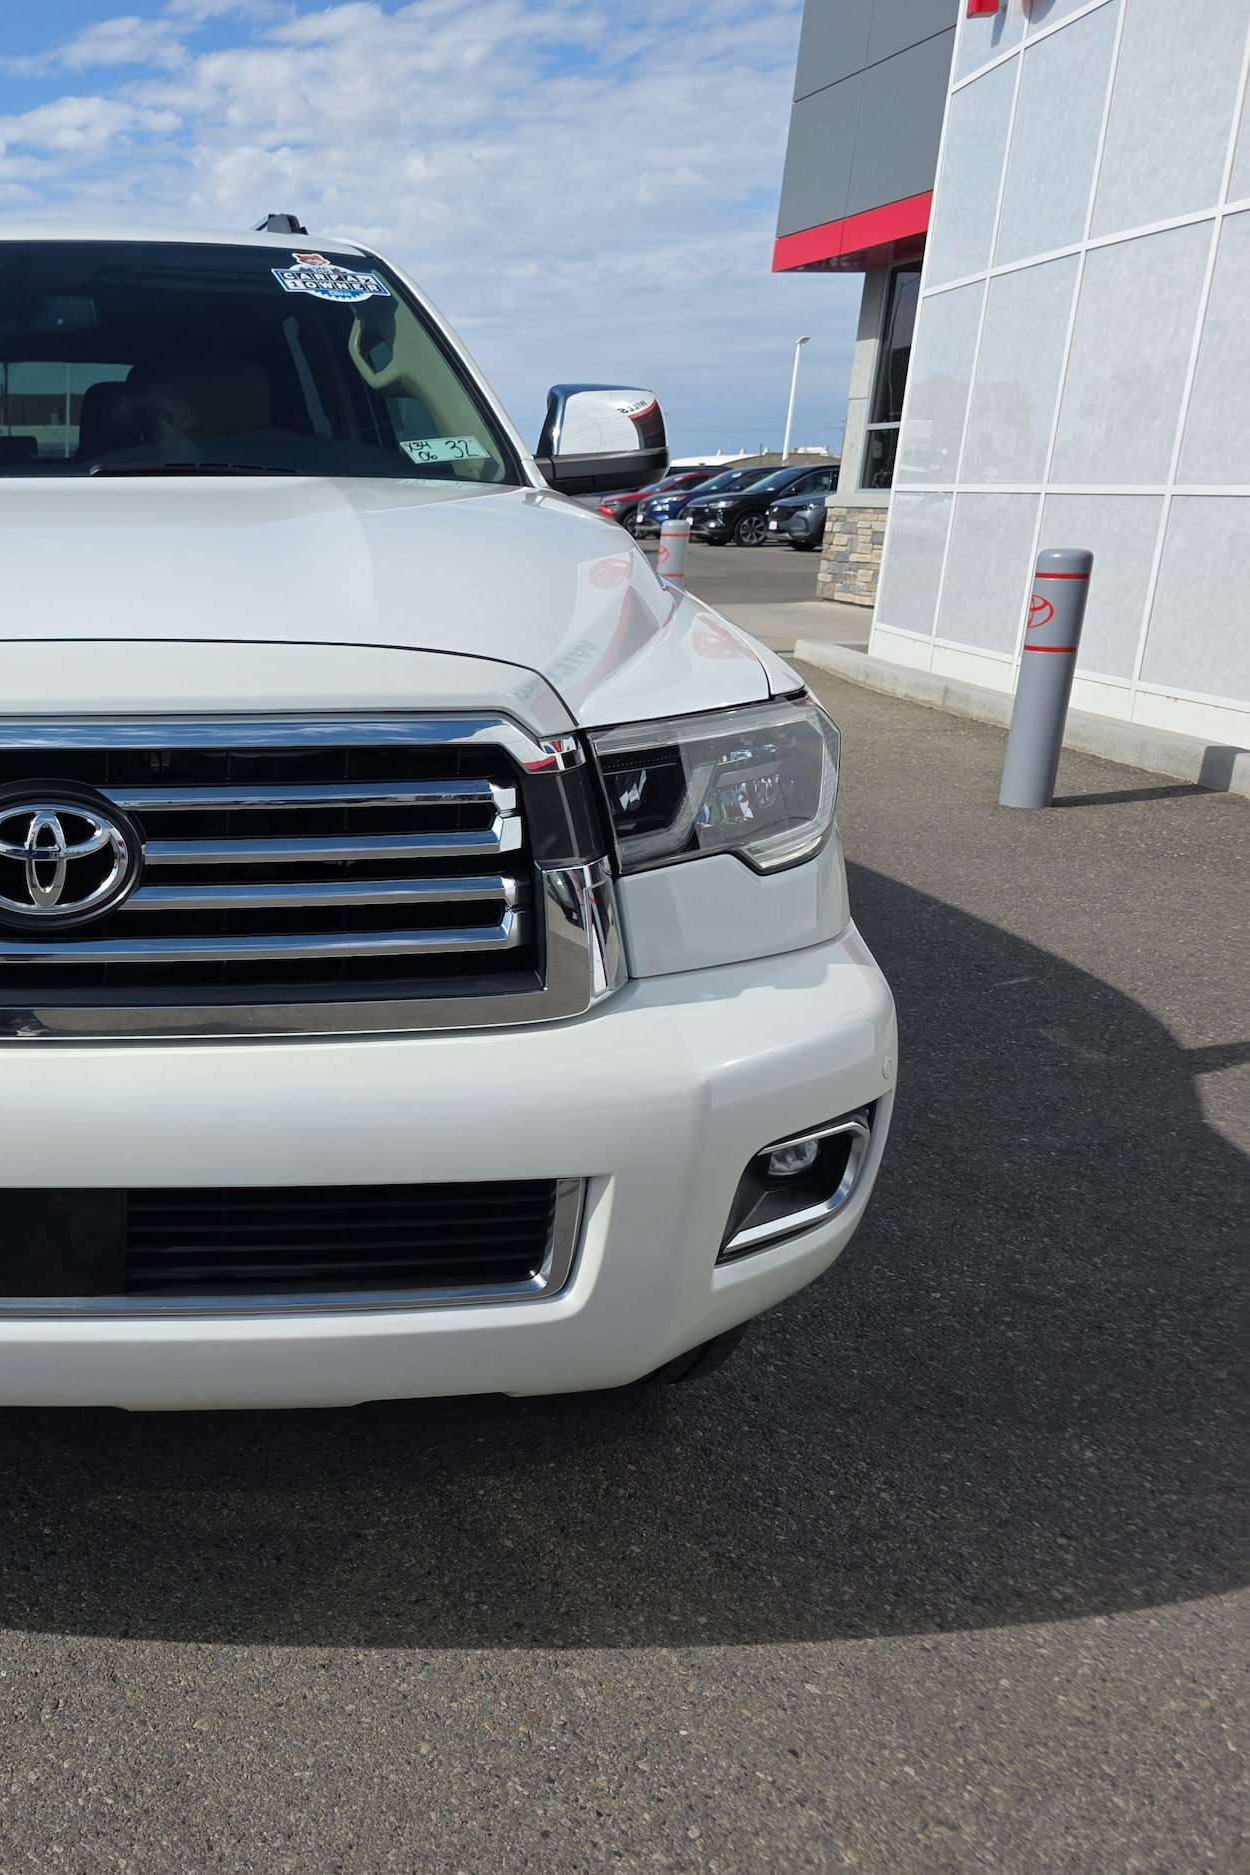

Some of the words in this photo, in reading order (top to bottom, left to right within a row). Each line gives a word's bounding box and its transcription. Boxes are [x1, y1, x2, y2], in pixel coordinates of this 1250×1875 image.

[283, 272, 374, 284] CARFAX
[305, 281, 379, 291] OWNER
[445, 440, 479, 458] 32
